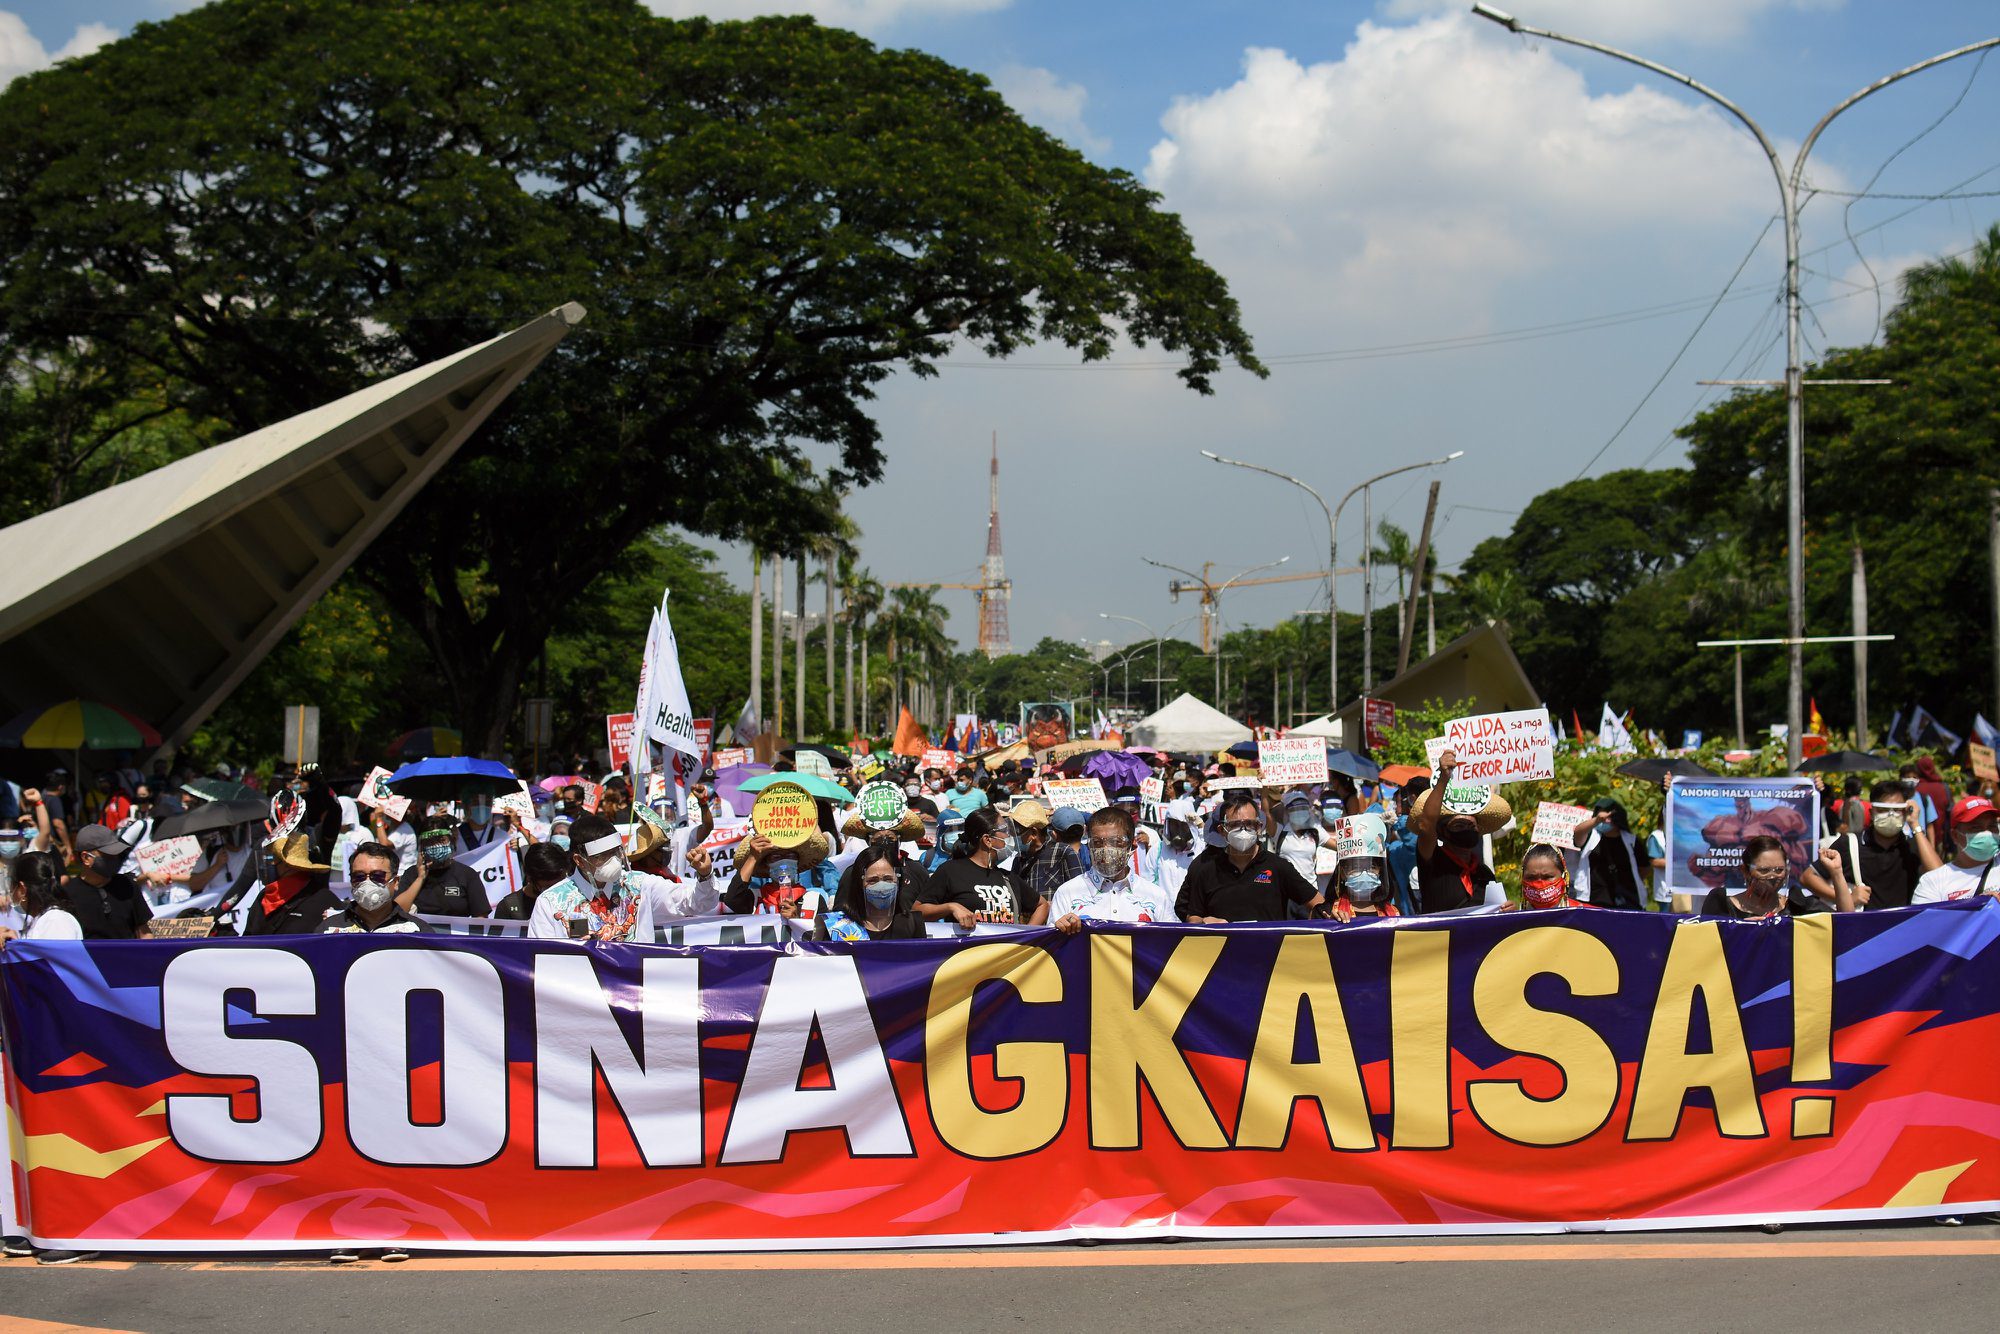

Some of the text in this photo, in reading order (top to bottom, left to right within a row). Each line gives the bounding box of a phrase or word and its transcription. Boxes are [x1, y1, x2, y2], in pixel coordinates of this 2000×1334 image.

[655, 702, 694, 740] Health
[1449, 717, 1542, 742] AYUDA sa mga
[1262, 741, 1281, 751] MASS
[1284, 740, 1307, 750] HIRING
[1454, 737, 1530, 757] MAGSASAKA
[1531, 735, 1550, 747] hindi
[1263, 764, 1287, 775] HEALTH
[1456, 753, 1536, 781] TERROR LAW!
[1680, 788, 1806, 798] ANONG HALALAN 2022?
[769, 805, 800, 817] JUNK
[861, 799, 901, 817] PESTE
[759, 818, 816, 829] TERROR LAW
[152, 848, 184, 865] for all
[162, 912, 1836, 1169] SONAGKAISA!
